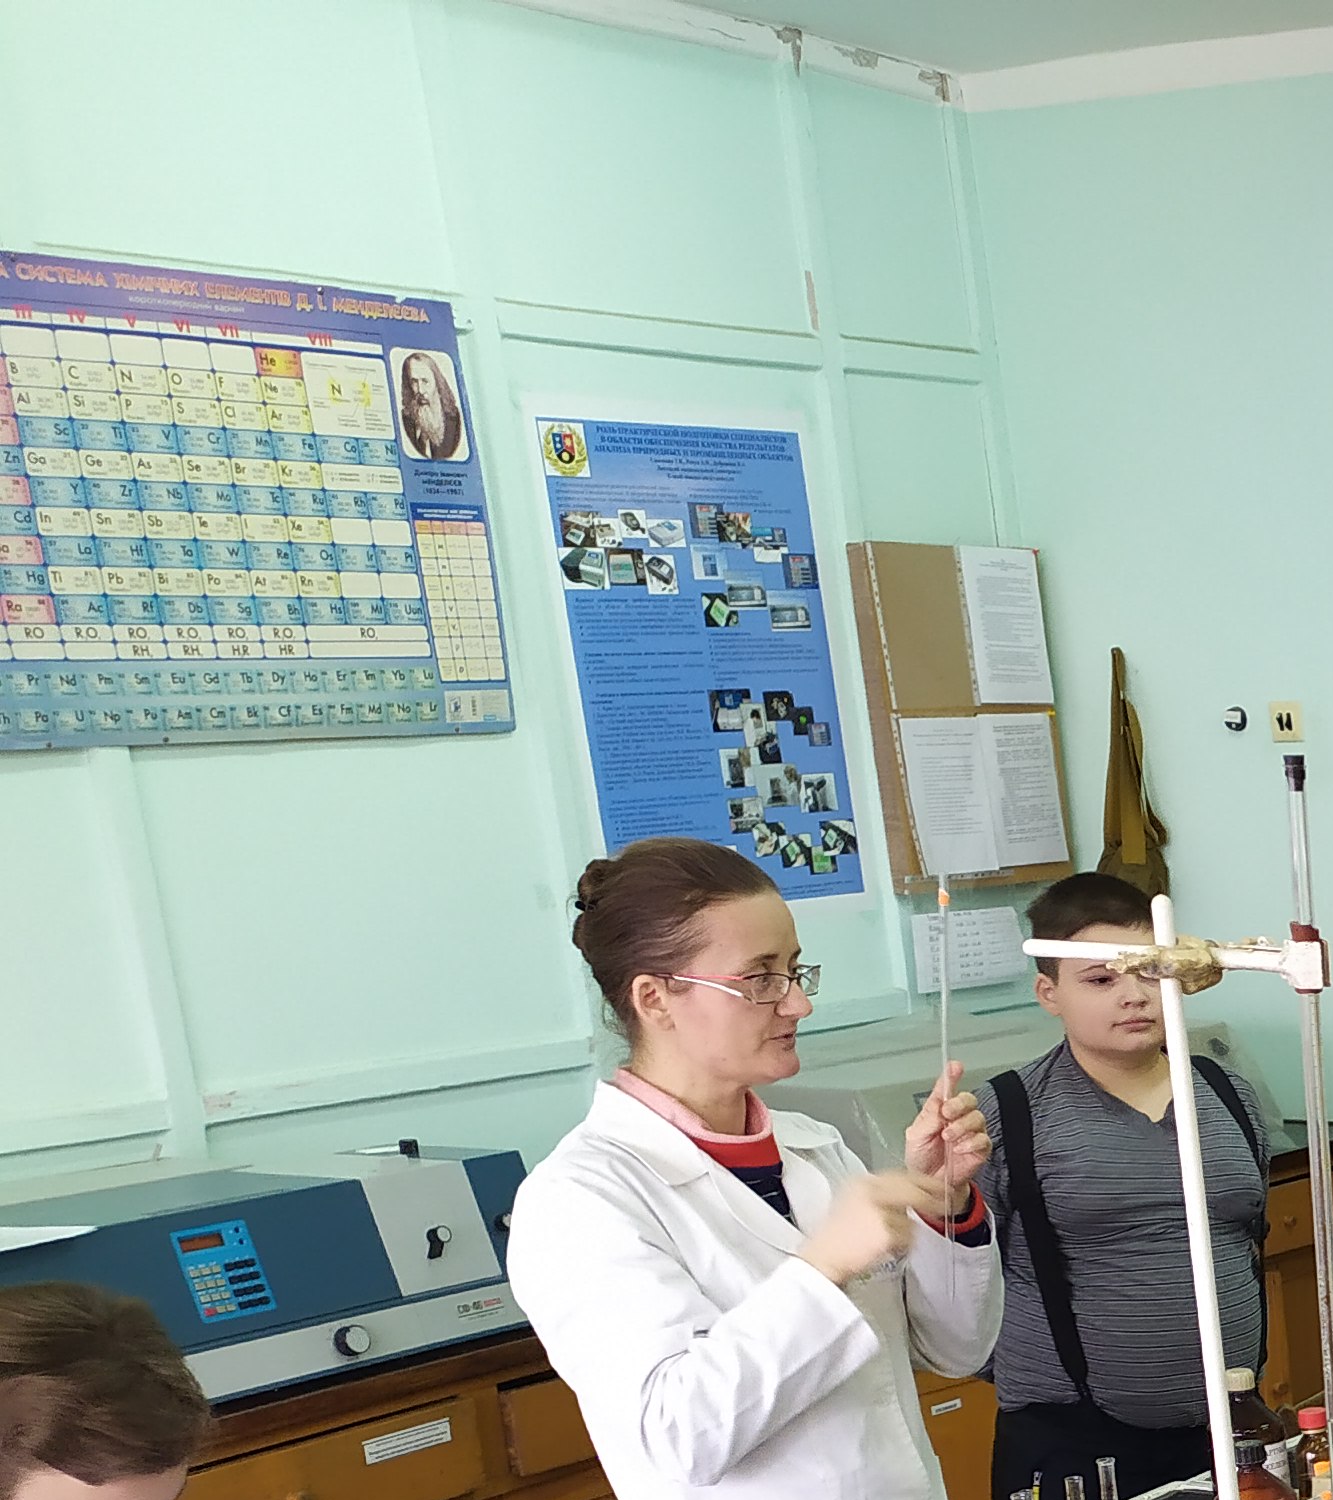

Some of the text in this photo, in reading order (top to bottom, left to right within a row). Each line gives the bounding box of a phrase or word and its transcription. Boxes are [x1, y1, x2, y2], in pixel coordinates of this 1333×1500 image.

[15, 263, 108, 288] СИСТЕМА
[67, 308, 87, 324] IV
[122, 313, 137, 329] V
[173, 319, 191, 334] VI
[218, 324, 240, 338] VII
[306, 333, 333, 347] VIII
[259, 353, 276, 366] He
[68, 366, 80, 380] C
[120, 370, 133, 384] N
[171, 373, 182, 385] O
[218, 376, 224, 388] F
[264, 382, 279, 394] Ne
[17, 392, 283, 421] Al Si P S Cl Ar
[54, 424, 357, 453] Sc Ti V Cr Mn Fe Co
[4, 451, 293, 477] Zn Ga Ge As Se Br Kr
[70, 482, 405, 510] Y Zr Nb Mo Tc Ru Rh Pd
[13, 510, 303, 532] Cd In Sn Sb Te Xe
[78, 543, 334, 562] La Hf Ta W Re Os
[26, 571, 314, 587] Hg Pb Bi Po Rn
[6, 601, 343, 617] Ra Ac Db Sg Bh Hs
[27, 669, 434, 687] Pr Nd Pm Sm Eu Gd Tb Dy Ho Er Tm Yb Lu
[35, 703, 411, 724] Pa U Np Pu Am Cm Cf Es Md No
